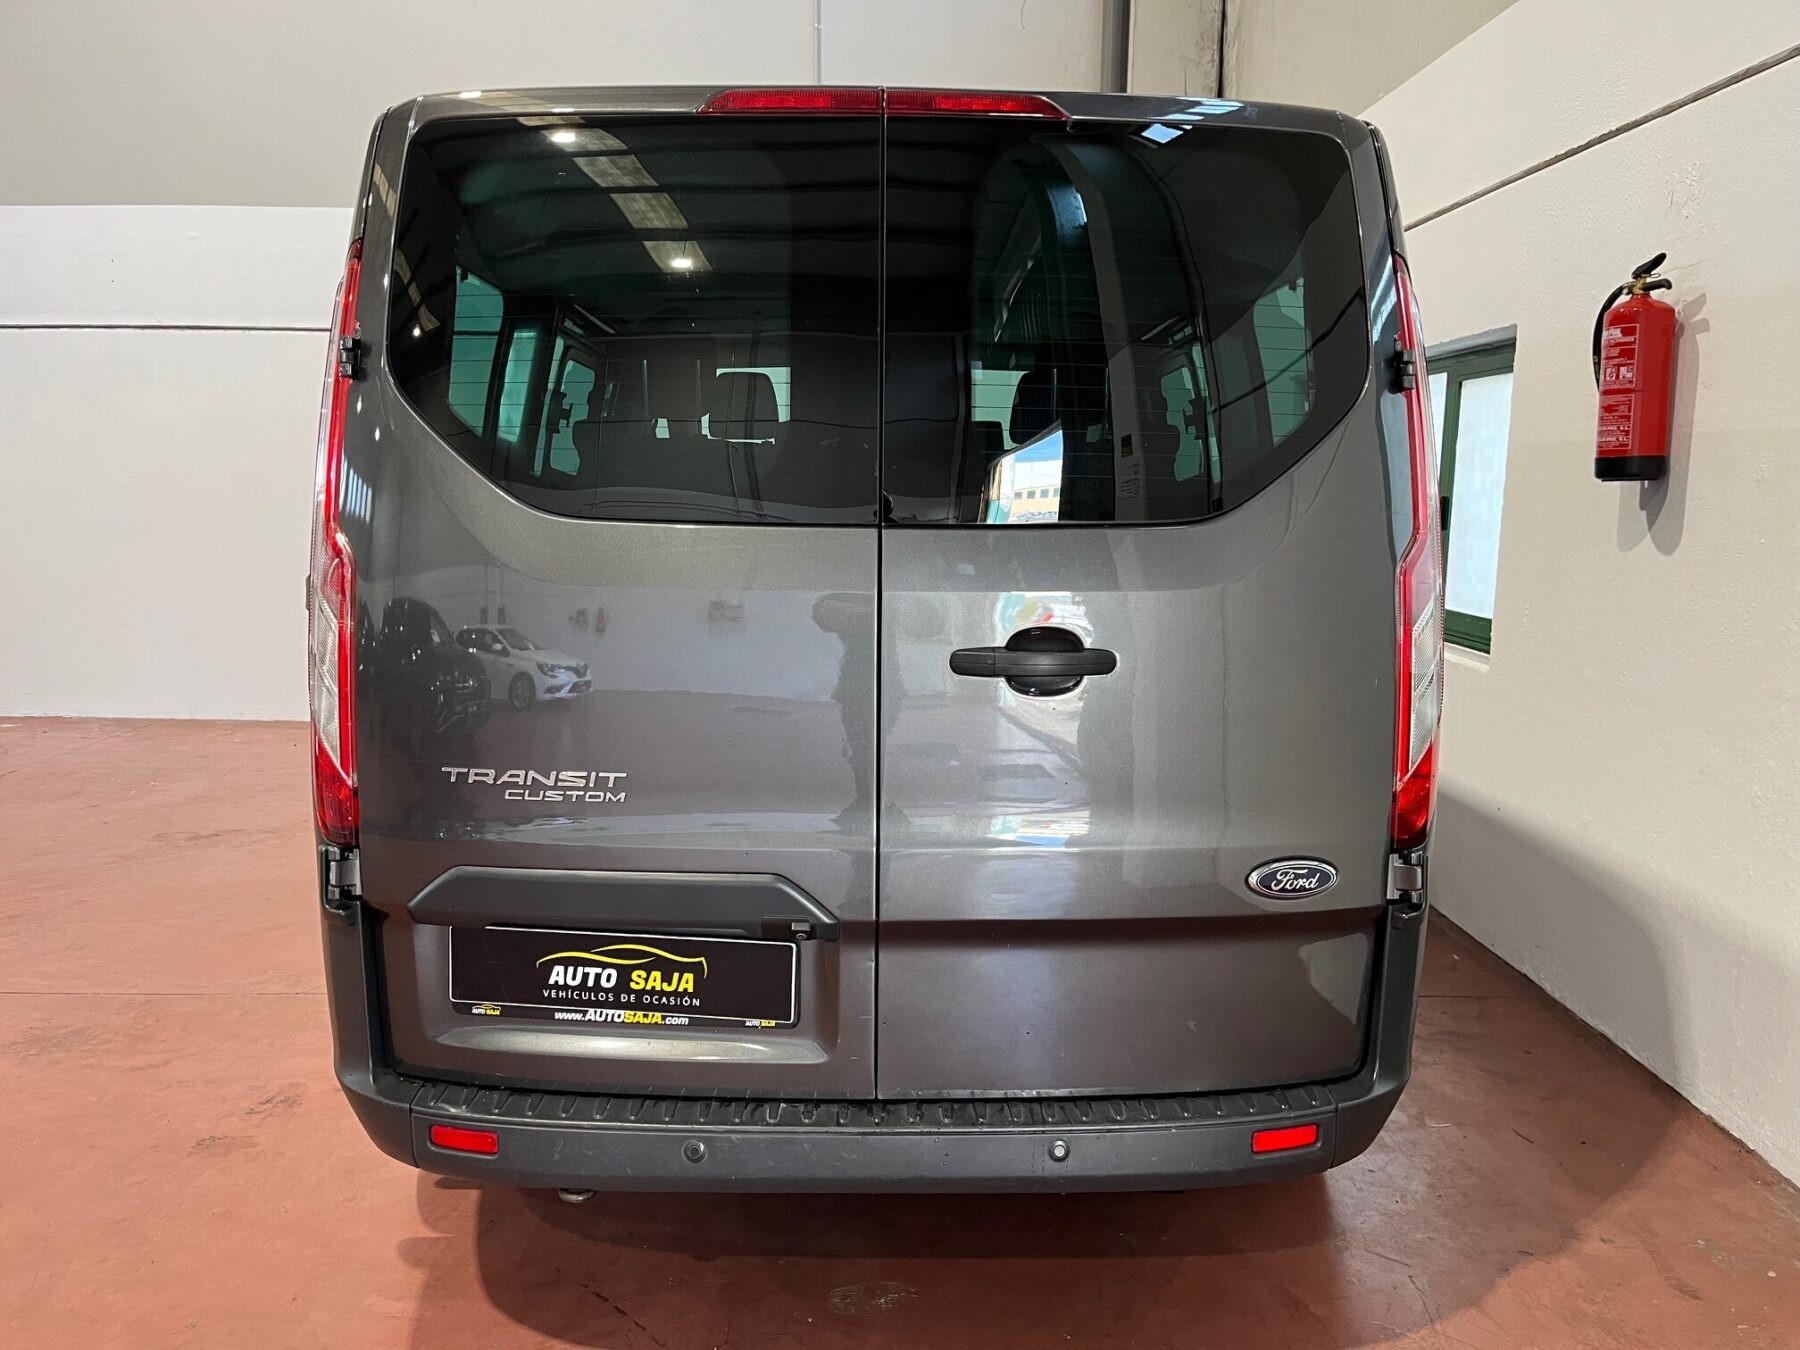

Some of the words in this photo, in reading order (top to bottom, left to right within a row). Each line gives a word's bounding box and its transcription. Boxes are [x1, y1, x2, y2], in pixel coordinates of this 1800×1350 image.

[441, 766, 628, 788] TRANSIT
[504, 789, 626, 803] CUSTOM
[1271, 868, 1321, 891] Ford
[548, 965, 618, 988] AUTO
[629, 969, 695, 993] SAJA
[542, 988, 614, 1002] VEHÍCULOS
[620, 993, 636, 1003] DE
[642, 994, 701, 1007] OCASIÓN
[554, 1009, 690, 1026] www.AUTOSAJA.com
